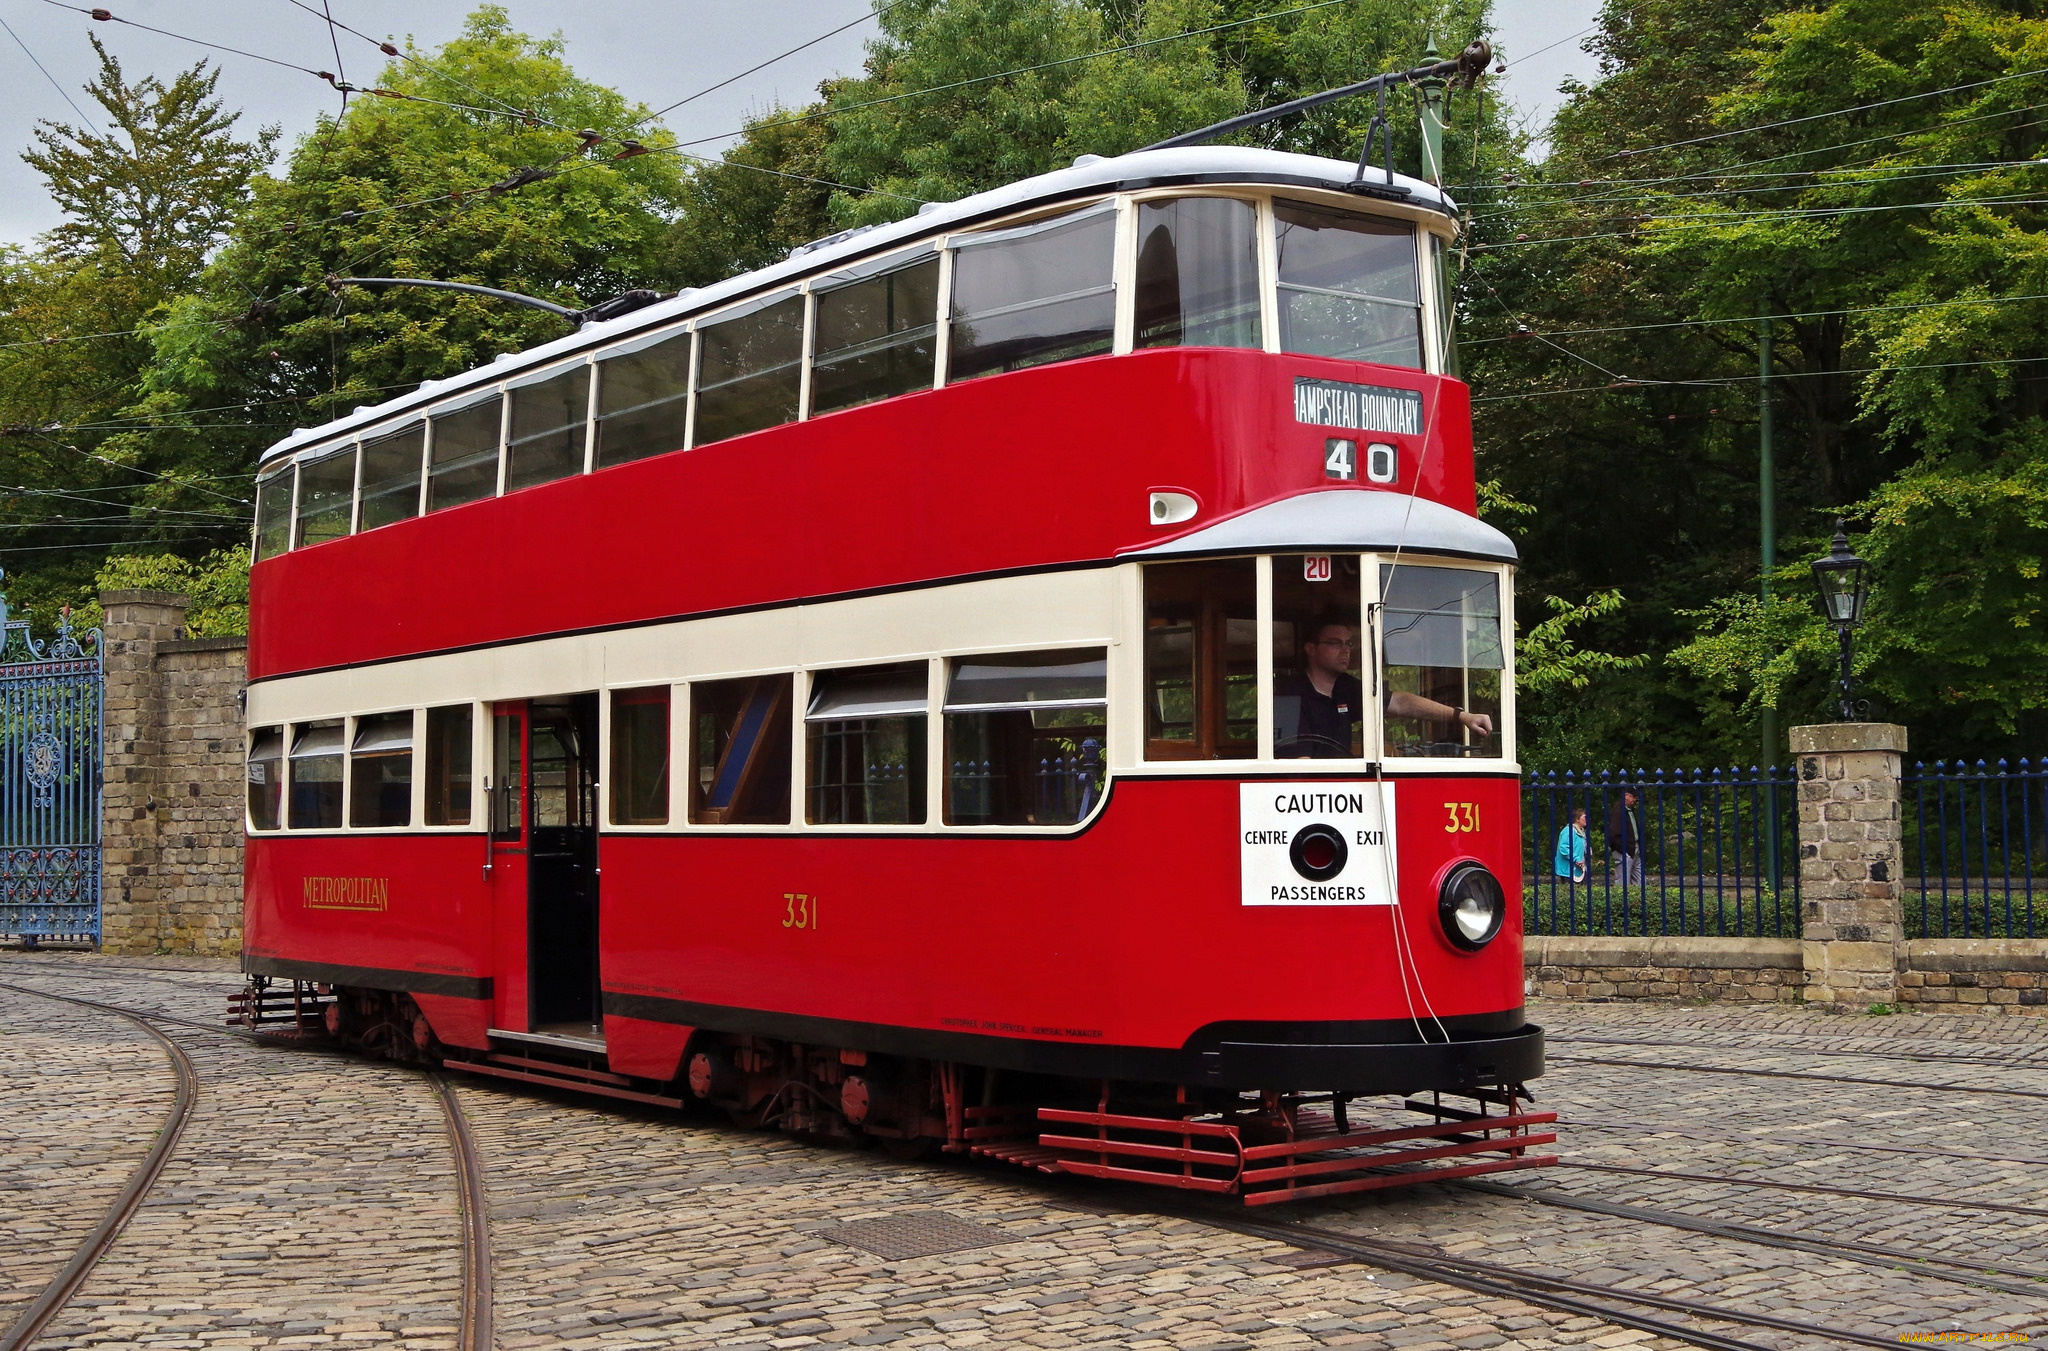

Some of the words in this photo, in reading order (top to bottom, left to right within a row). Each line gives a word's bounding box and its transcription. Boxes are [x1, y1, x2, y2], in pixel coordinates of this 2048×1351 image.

[1362, 394, 1418, 435] BOUNDARY
[1306, 556, 1328, 578] 20
[1275, 794, 1363, 813] CAUTION
[1444, 802, 1480, 833] 331
[1245, 831, 1288, 845] CENTRE
[1357, 831, 1383, 845] EXIT
[303, 877, 388, 911] METROPOLITAN
[1271, 886, 1365, 900] PASSENGERS
[782, 893, 817, 930] 331
[1066, 1028, 1103, 1038] MANAGER
